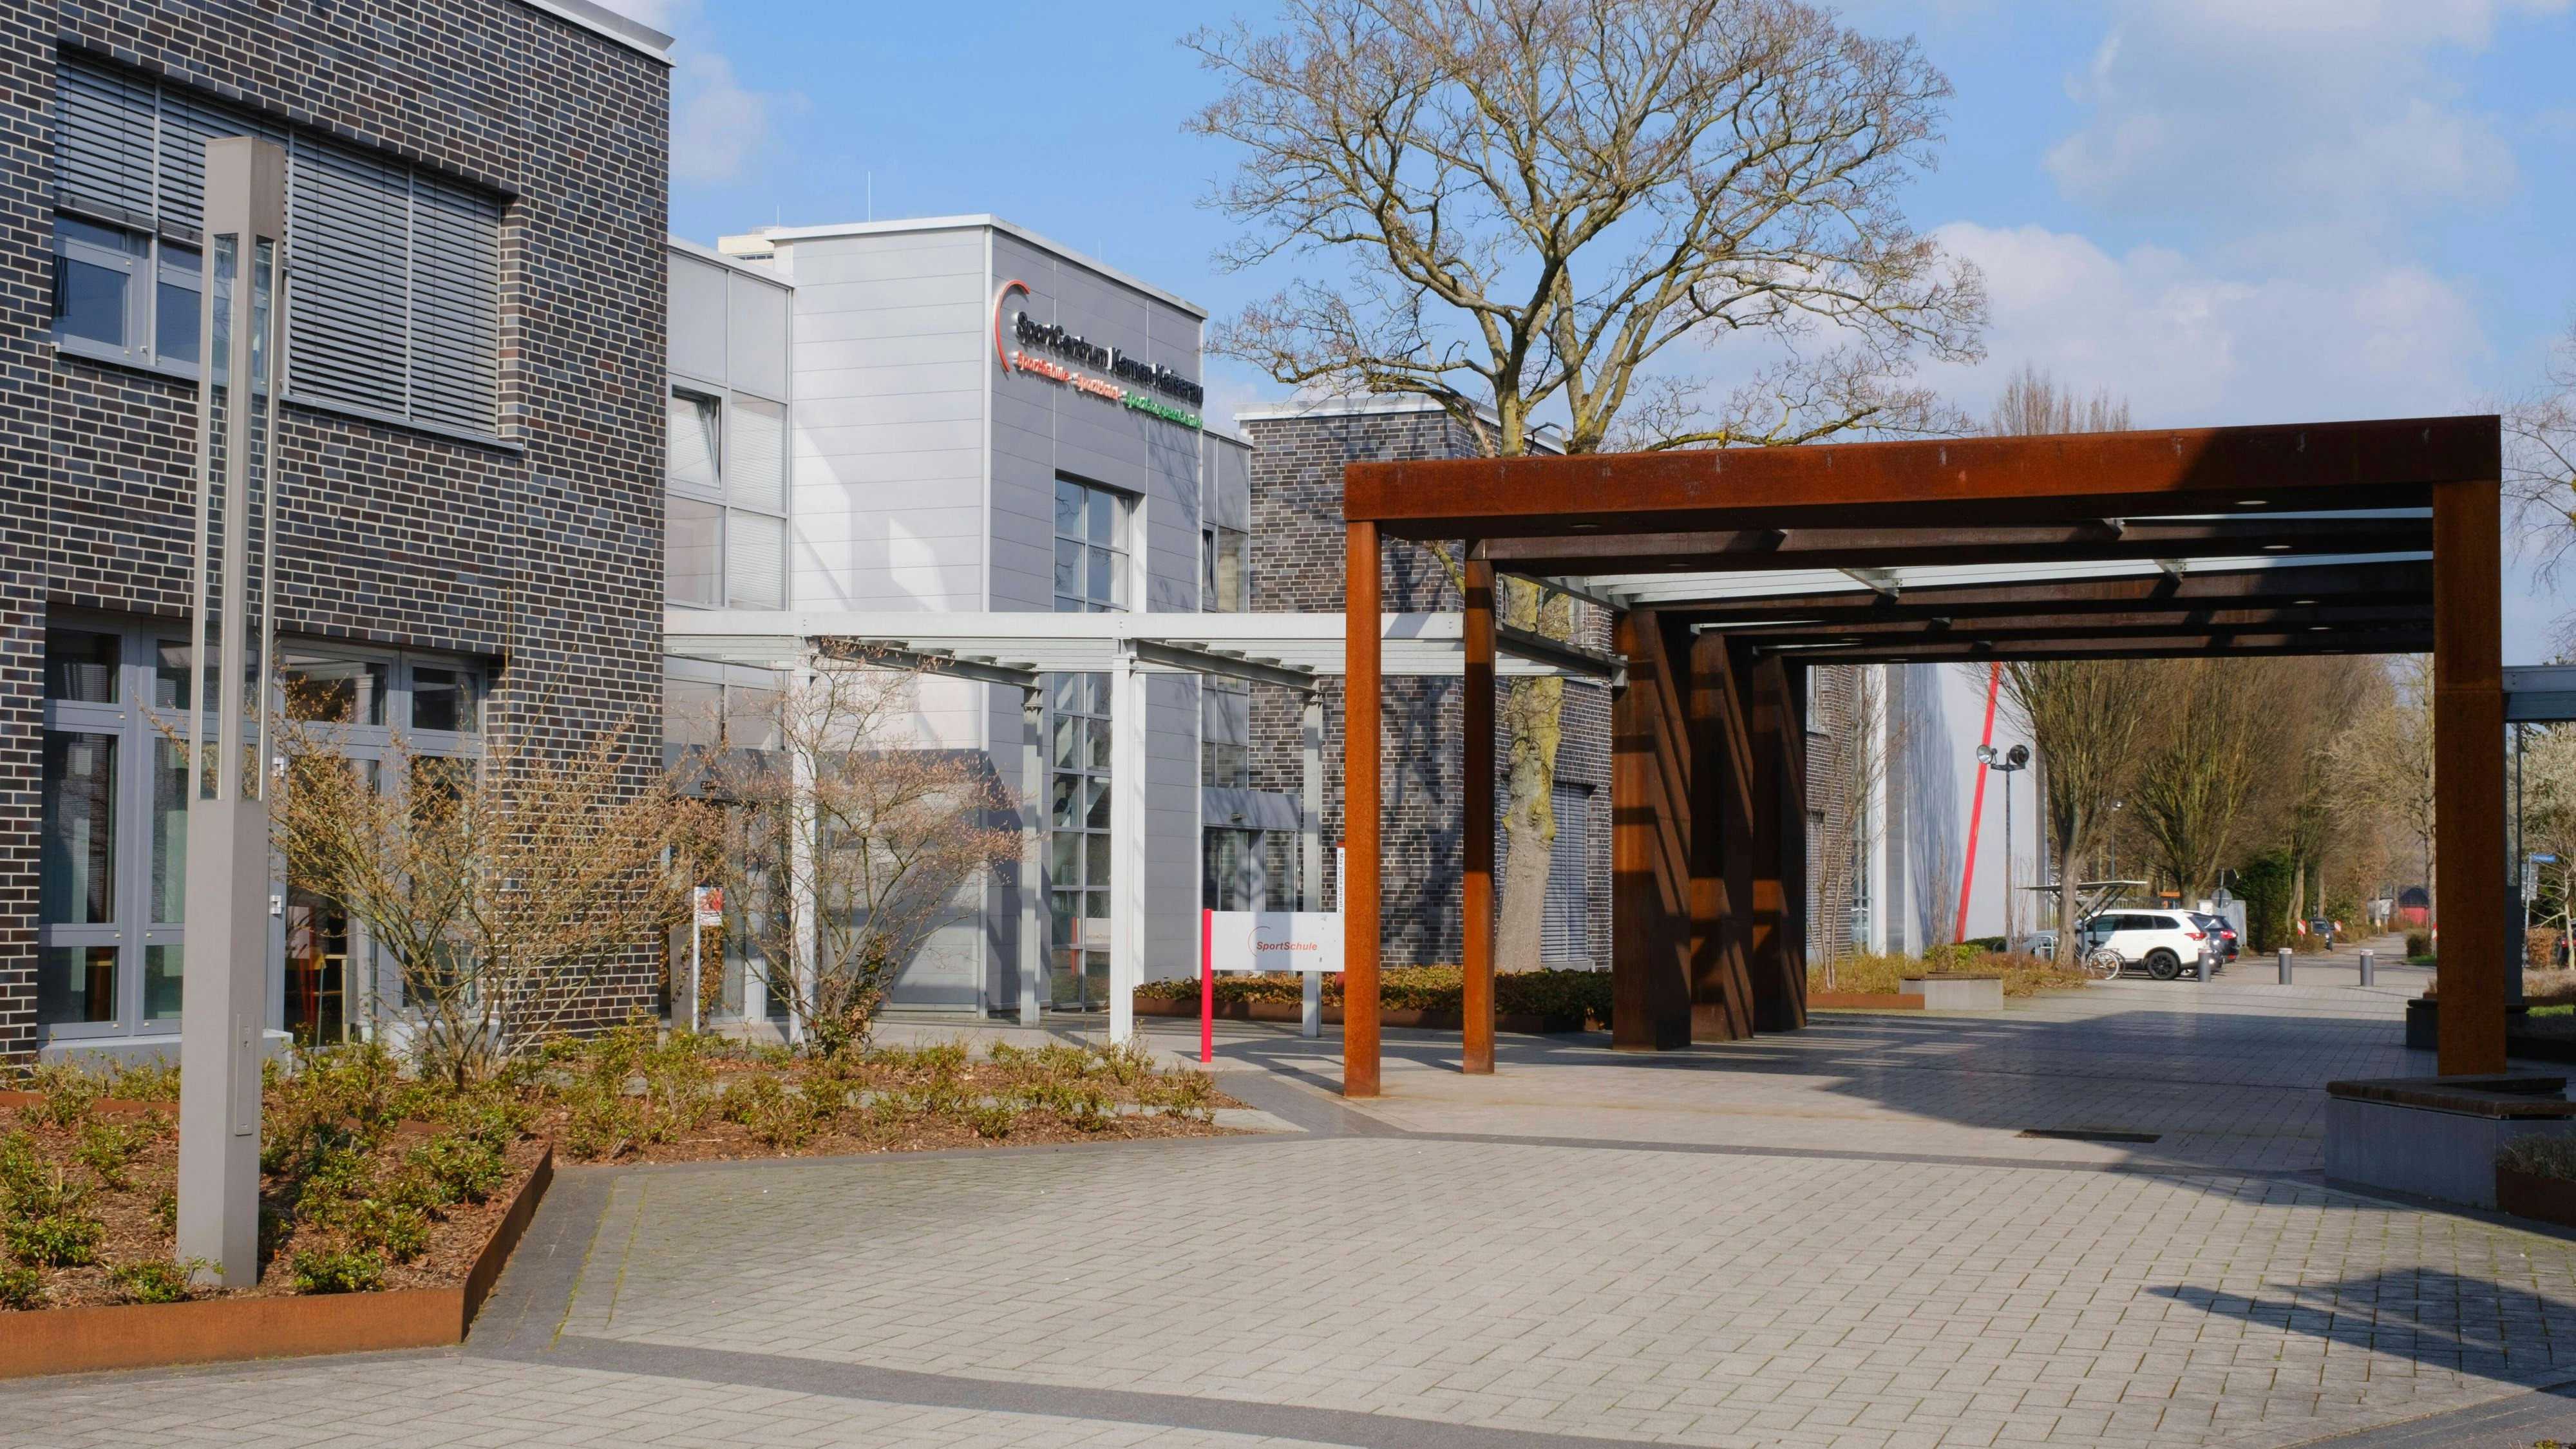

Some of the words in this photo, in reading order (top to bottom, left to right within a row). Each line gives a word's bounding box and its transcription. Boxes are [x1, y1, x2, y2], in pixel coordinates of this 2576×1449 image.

[1016, 312, 1109, 366] SportCentrum
[1112, 347, 1204, 402] Kamen-Kaiserau
[1017, 350, 1070, 382] SportSchule
[1256, 941, 1318, 952] SportSchule
